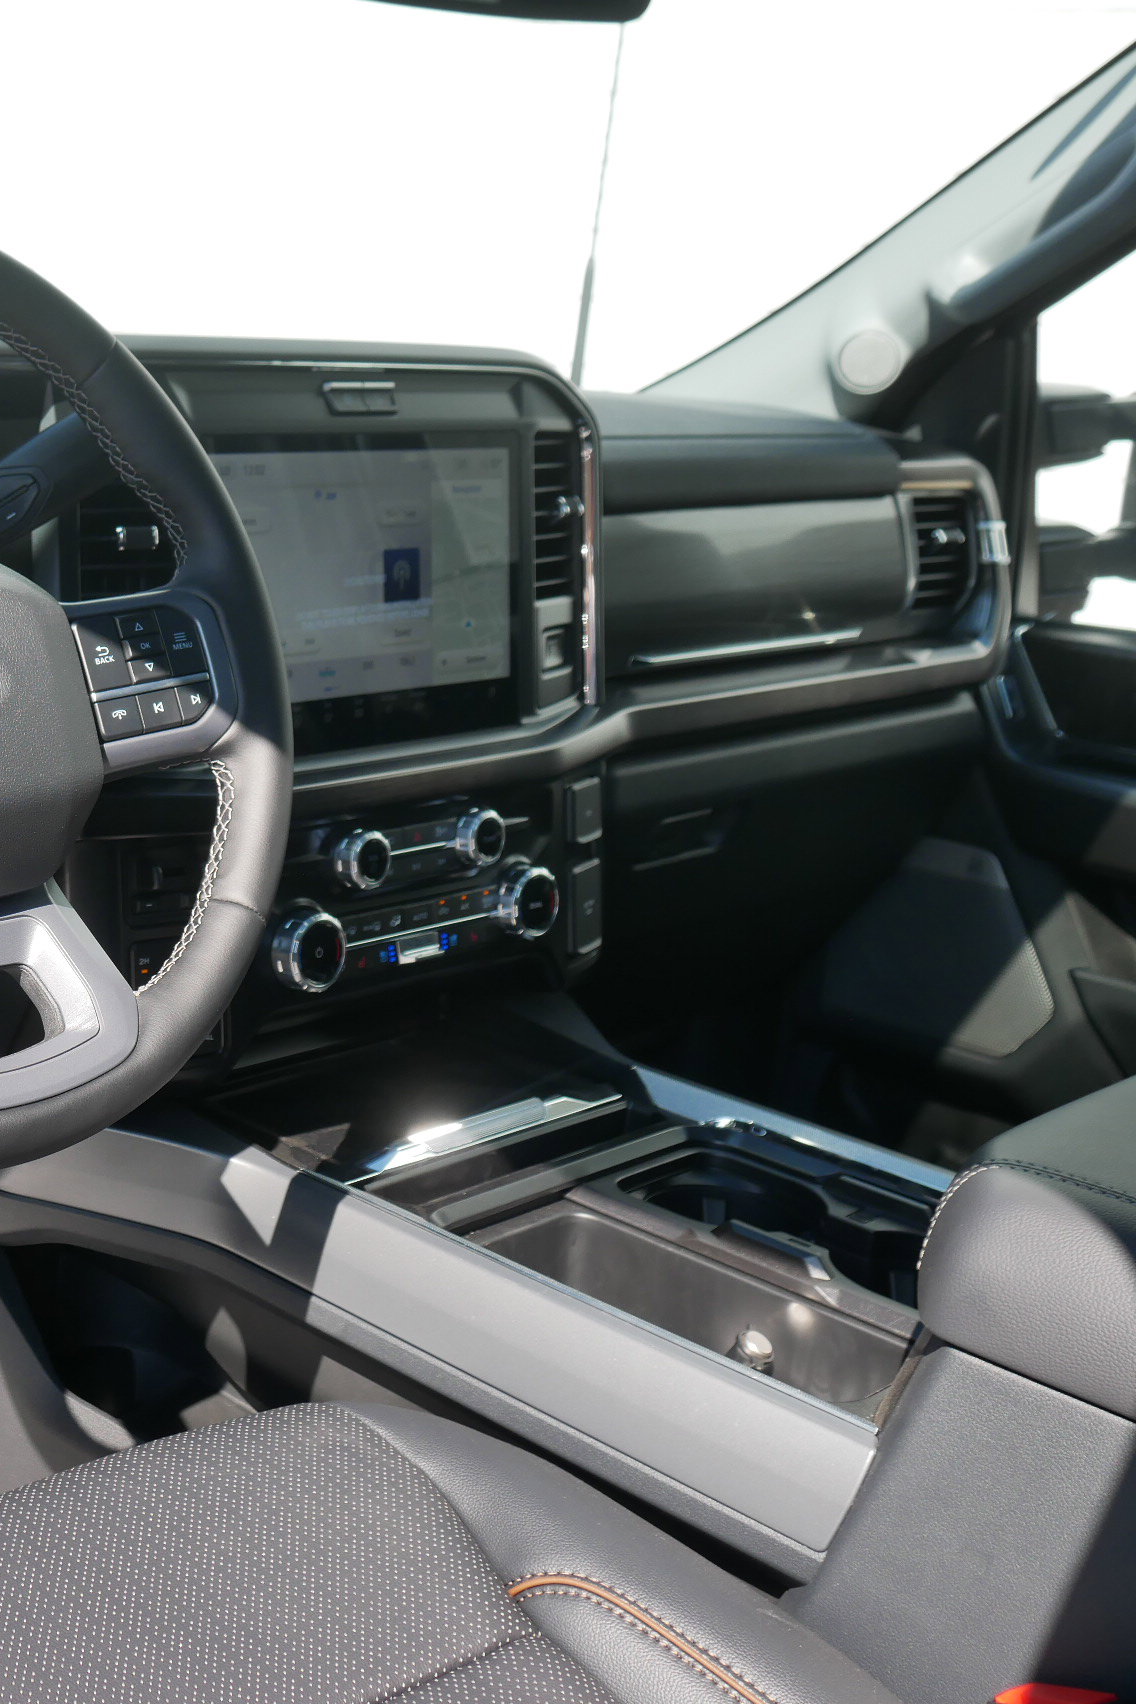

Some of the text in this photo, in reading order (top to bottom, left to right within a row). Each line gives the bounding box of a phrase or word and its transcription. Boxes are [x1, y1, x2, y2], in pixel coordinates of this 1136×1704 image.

[172, 642, 193, 650] MENU
[94, 655, 115, 665] BACK
[138, 957, 150, 966] 2H
